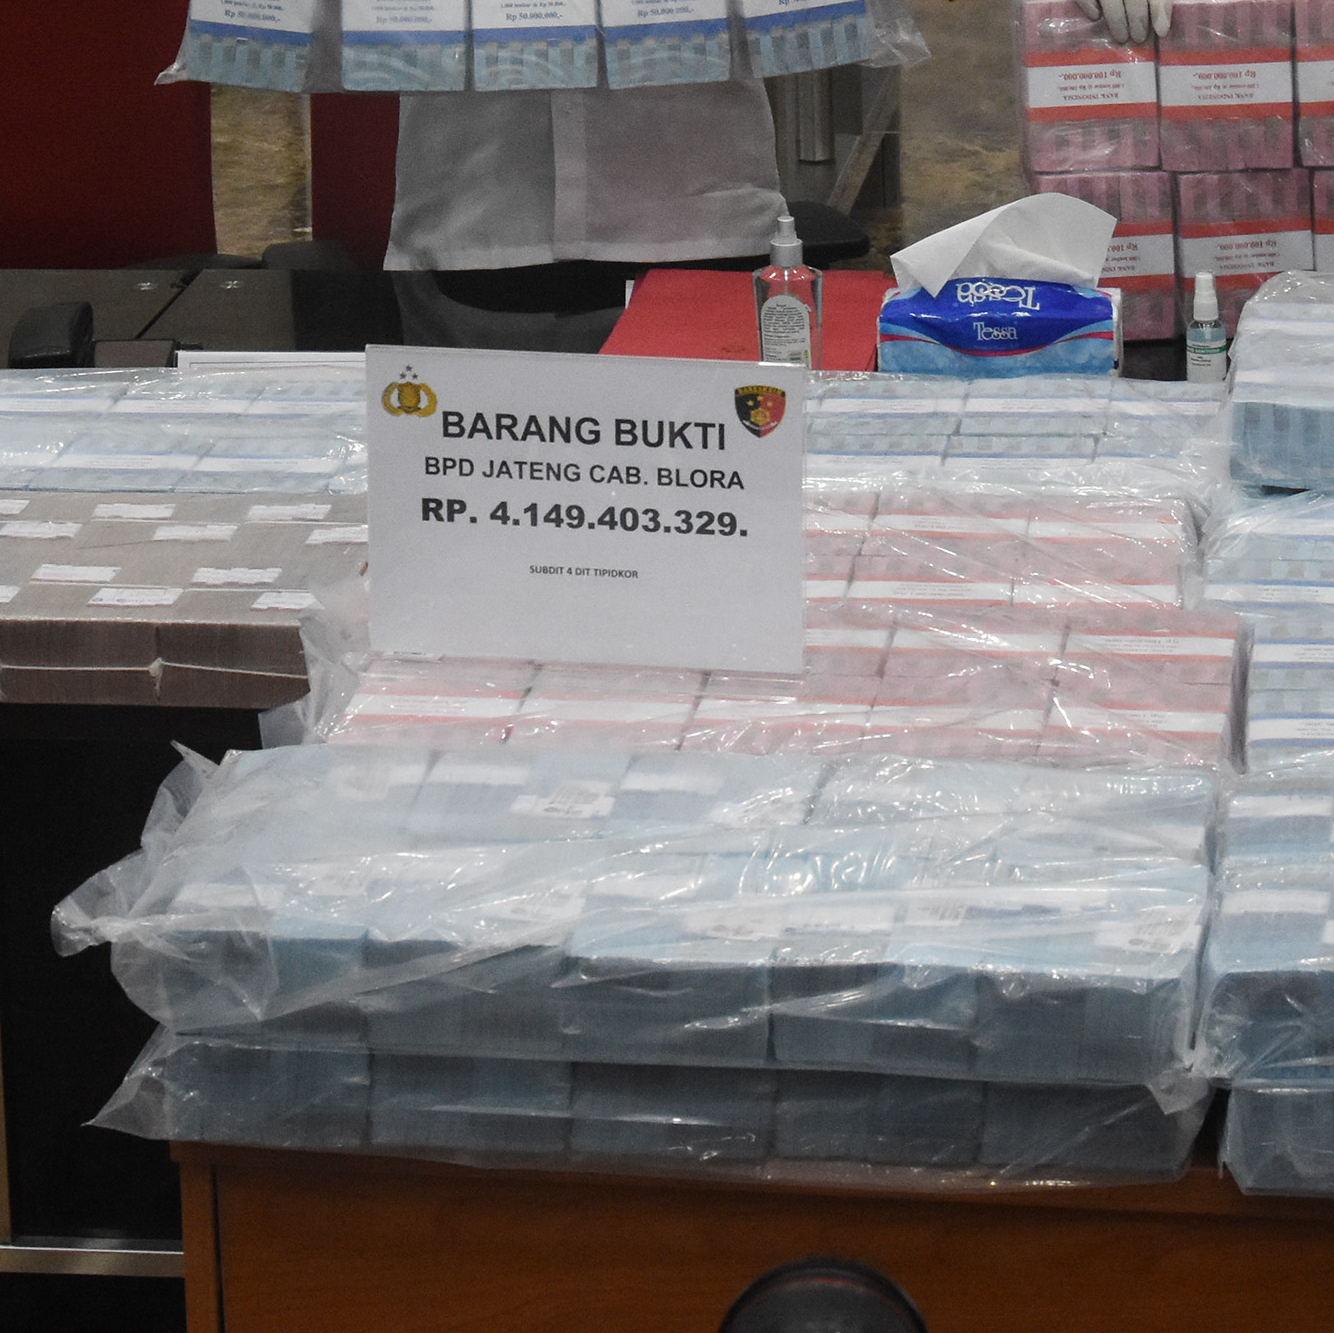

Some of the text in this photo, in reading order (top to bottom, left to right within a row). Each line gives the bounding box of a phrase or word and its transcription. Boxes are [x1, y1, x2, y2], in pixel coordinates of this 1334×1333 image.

[225, 10, 236, 18] Rp
[506, 13, 517, 21] Rp
[637, 9, 648, 17] Rp
[1110, 70, 1121, 79] Rp
[1245, 70, 1256, 78] Rp
[957, 282, 1040, 310] Tessa
[973, 322, 1018, 341] Tessa
[443, 411, 724, 450] BARANG BUKTI
[425, 457, 744, 489] BPD JATENG CAB. BLORA
[422, 498, 747, 536] RP. 4.149.403.329.
[530, 565, 638, 578] SUBDIT 4 DIT TIPIDKOR
